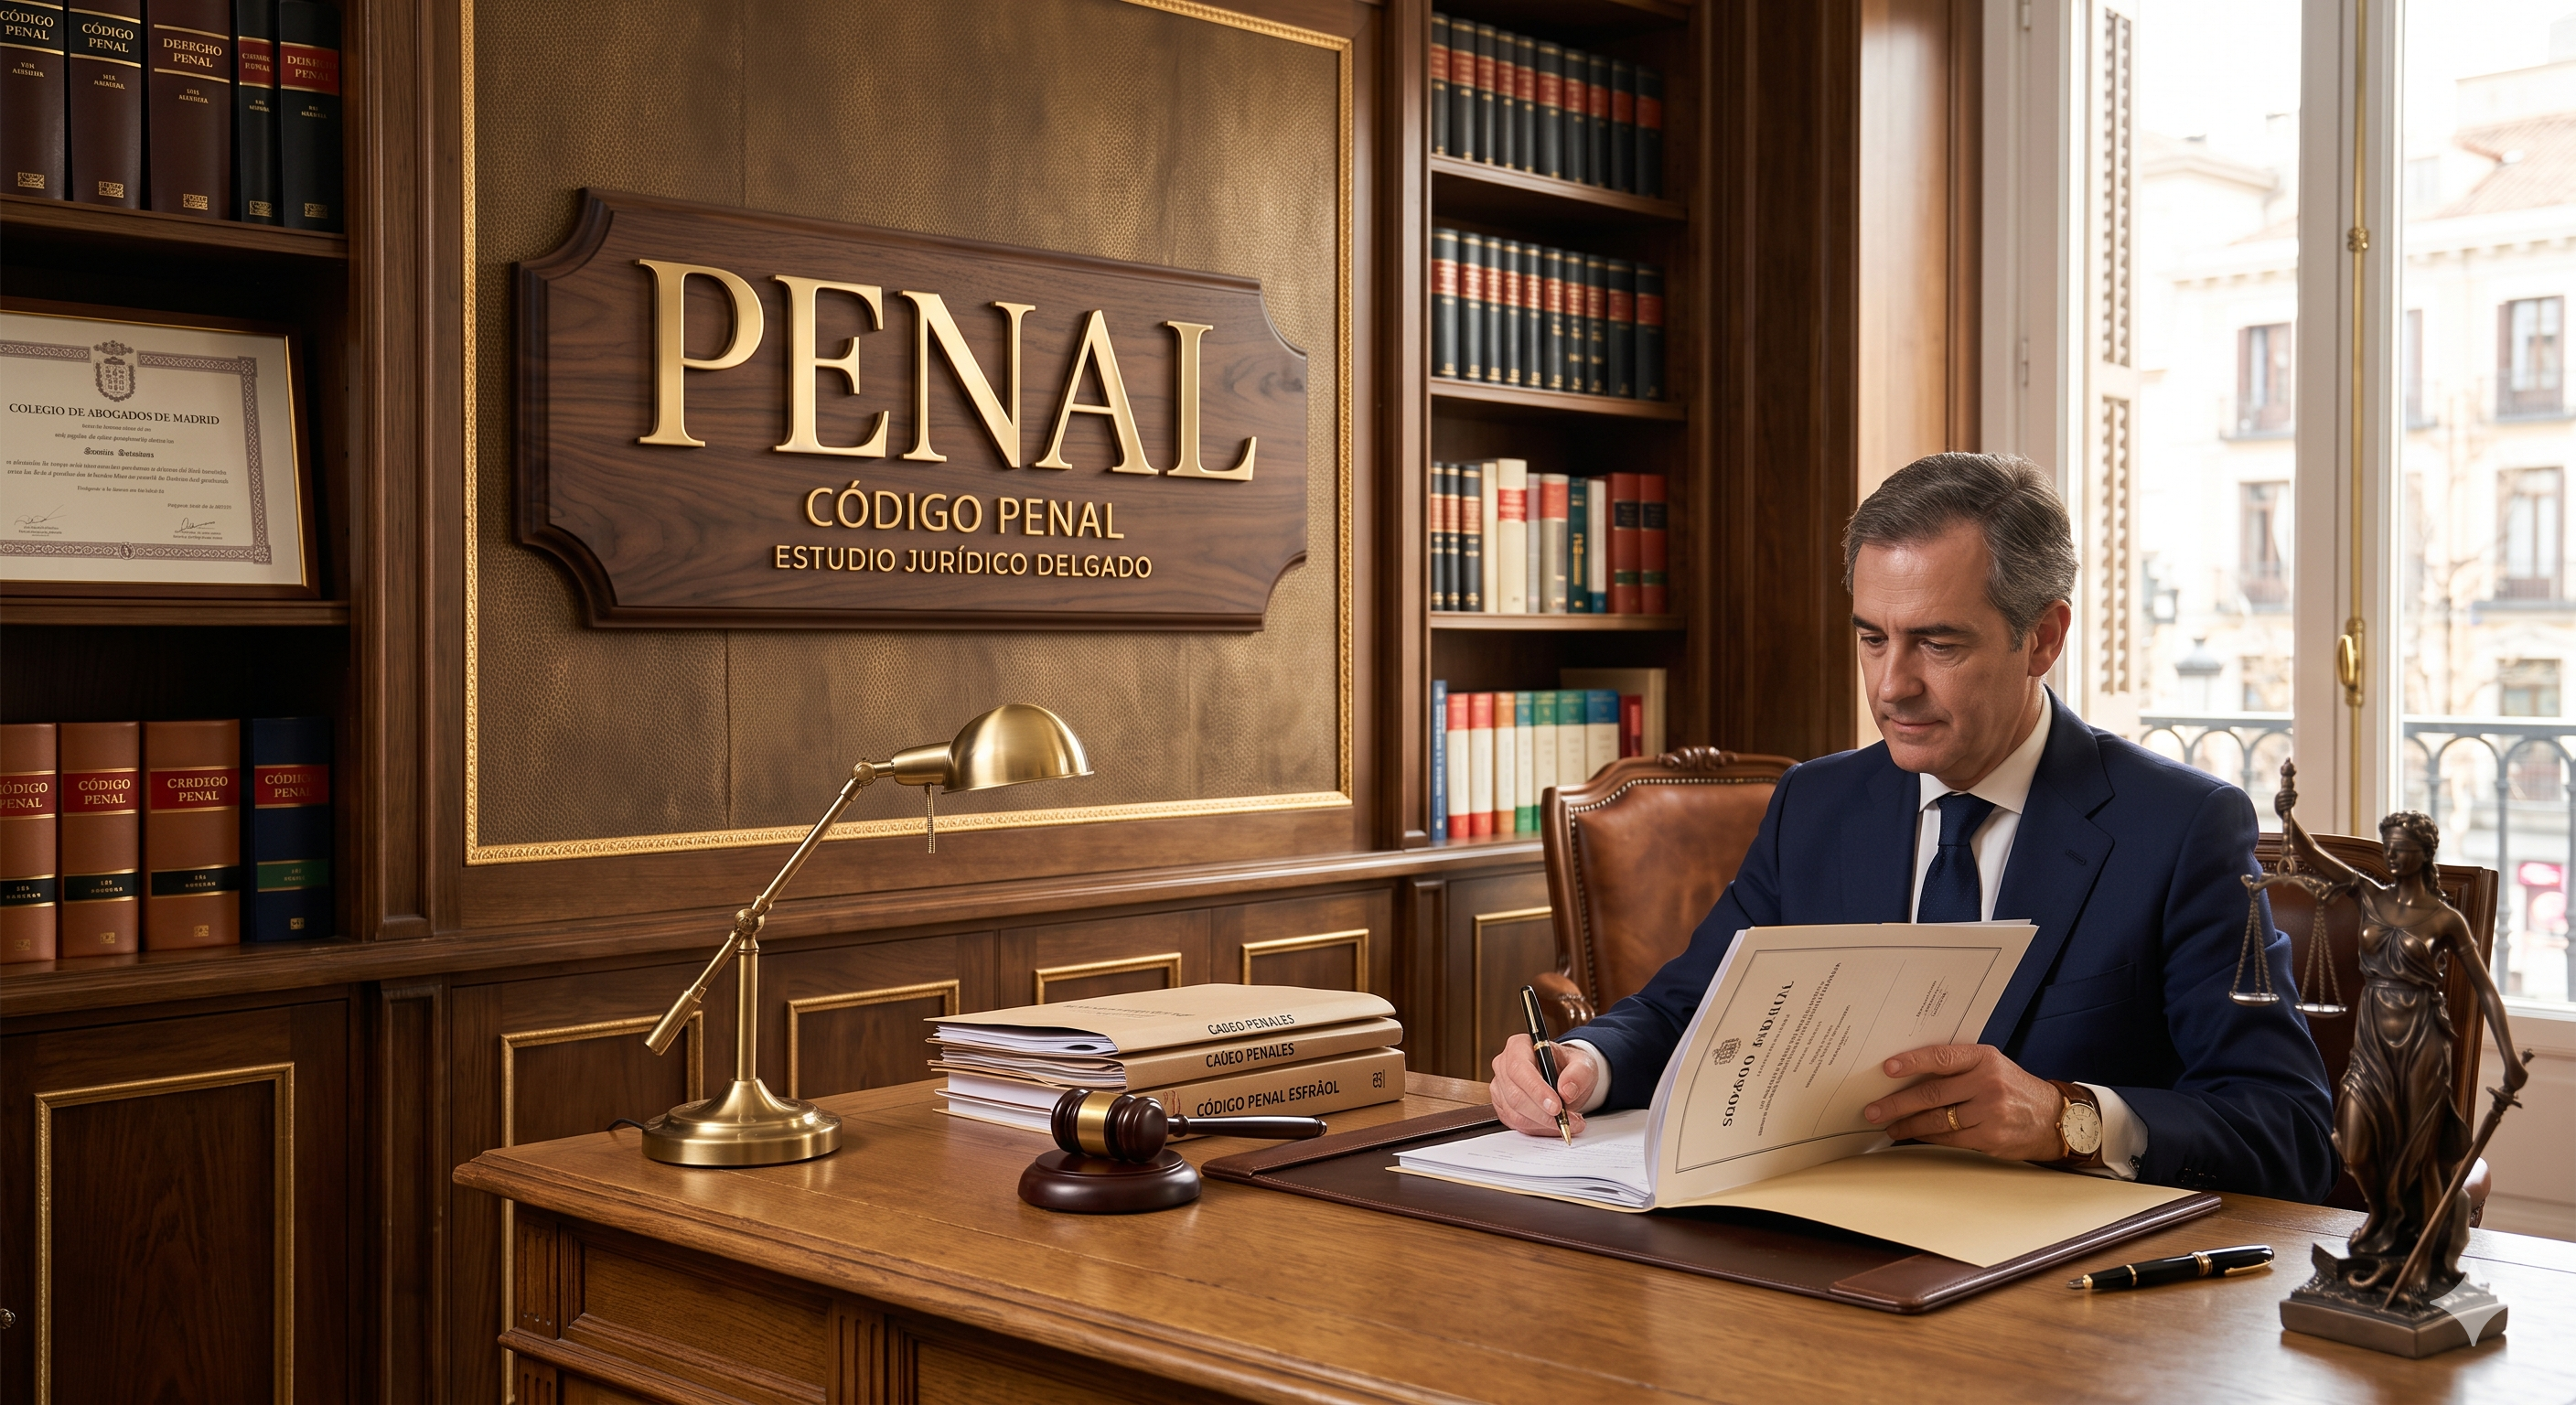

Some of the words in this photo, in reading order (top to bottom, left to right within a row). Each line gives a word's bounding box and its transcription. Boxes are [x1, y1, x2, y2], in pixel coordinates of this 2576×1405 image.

[0, 9, 54, 27] CÓDIGO
[5, 25, 49, 40] PENAL
[81, 22, 134, 40] CÓDIGO
[88, 38, 129, 53] PENAL
[173, 52, 213, 68] PENAL
[295, 69, 331, 81] PENAL
[634, 258, 1258, 482] PENAL
[9, 402, 65, 416] COLEGIO
[69, 407, 85, 417] DE
[88, 408, 153, 422] ABOGADOS
[155, 413, 170, 423] DE
[173, 413, 220, 425] MADRID
[805, 479, 983, 533] CÓDIGO
[997, 497, 1125, 540] PENAL
[775, 544, 897, 573] ESTUDIO
[904, 544, 1028, 576] JURÍDICO
[1036, 553, 1153, 579] DELGADO
[79, 778, 131, 791] CÓDIGO
[84, 794, 126, 805] PENAL
[178, 790, 220, 801] PENAL
[274, 788, 313, 798] PENAL
[1245, 1014, 1295, 1030] PENALES
[1246, 1042, 1295, 1062] PENALES
[1197, 1098, 1245, 1117] CÓDIGO
[1248, 1089, 1285, 1109] PENAL
